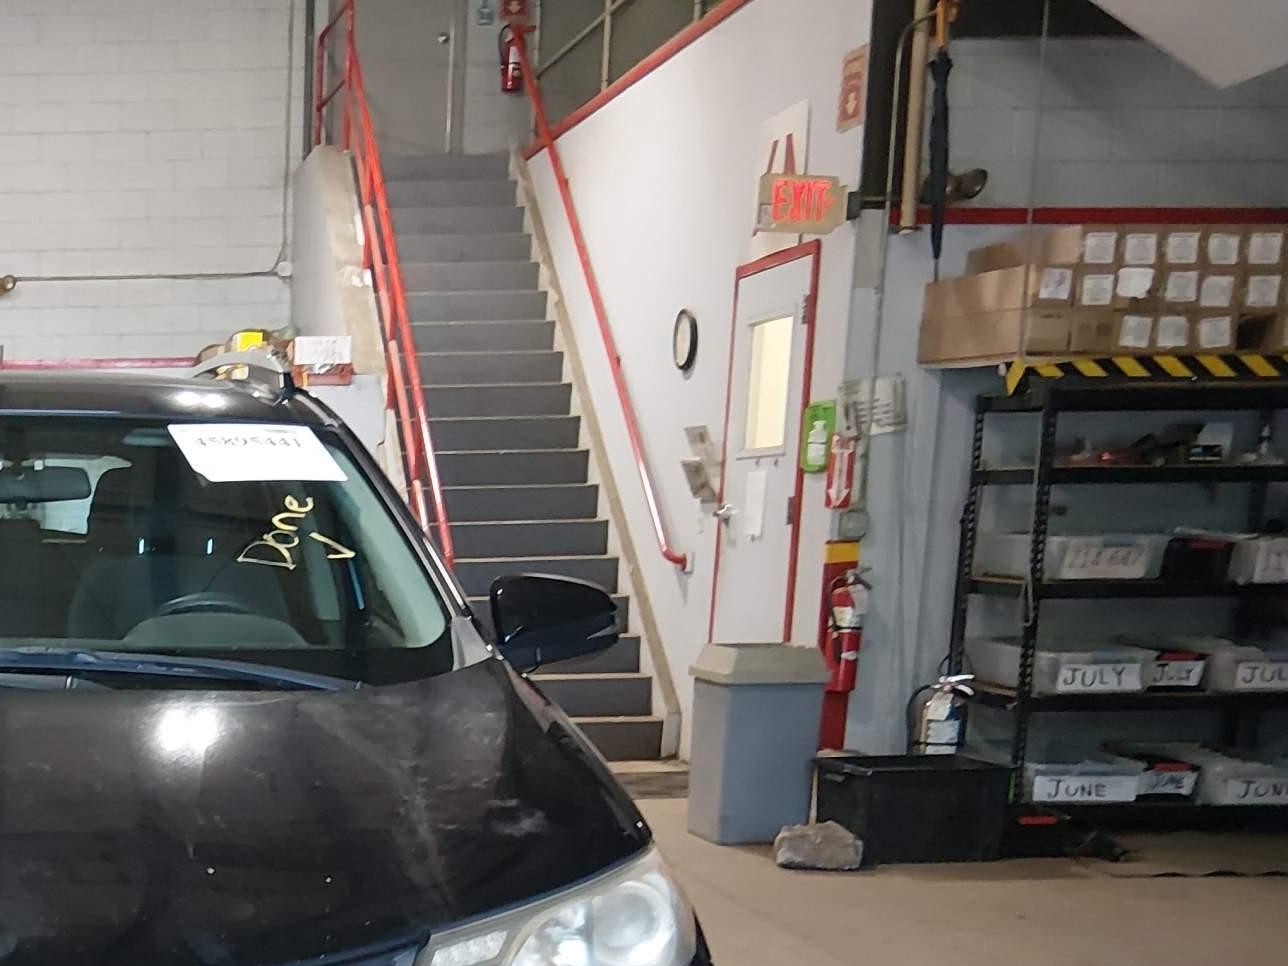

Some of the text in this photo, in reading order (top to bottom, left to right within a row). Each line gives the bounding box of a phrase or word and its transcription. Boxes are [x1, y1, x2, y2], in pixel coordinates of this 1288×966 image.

[772, 179, 830, 223] EXIT
[237, 495, 314, 570] Done
[1062, 666, 1126, 688] JULY
[1048, 778, 1107, 799] JUNE
[1238, 780, 1288, 800] JUN
